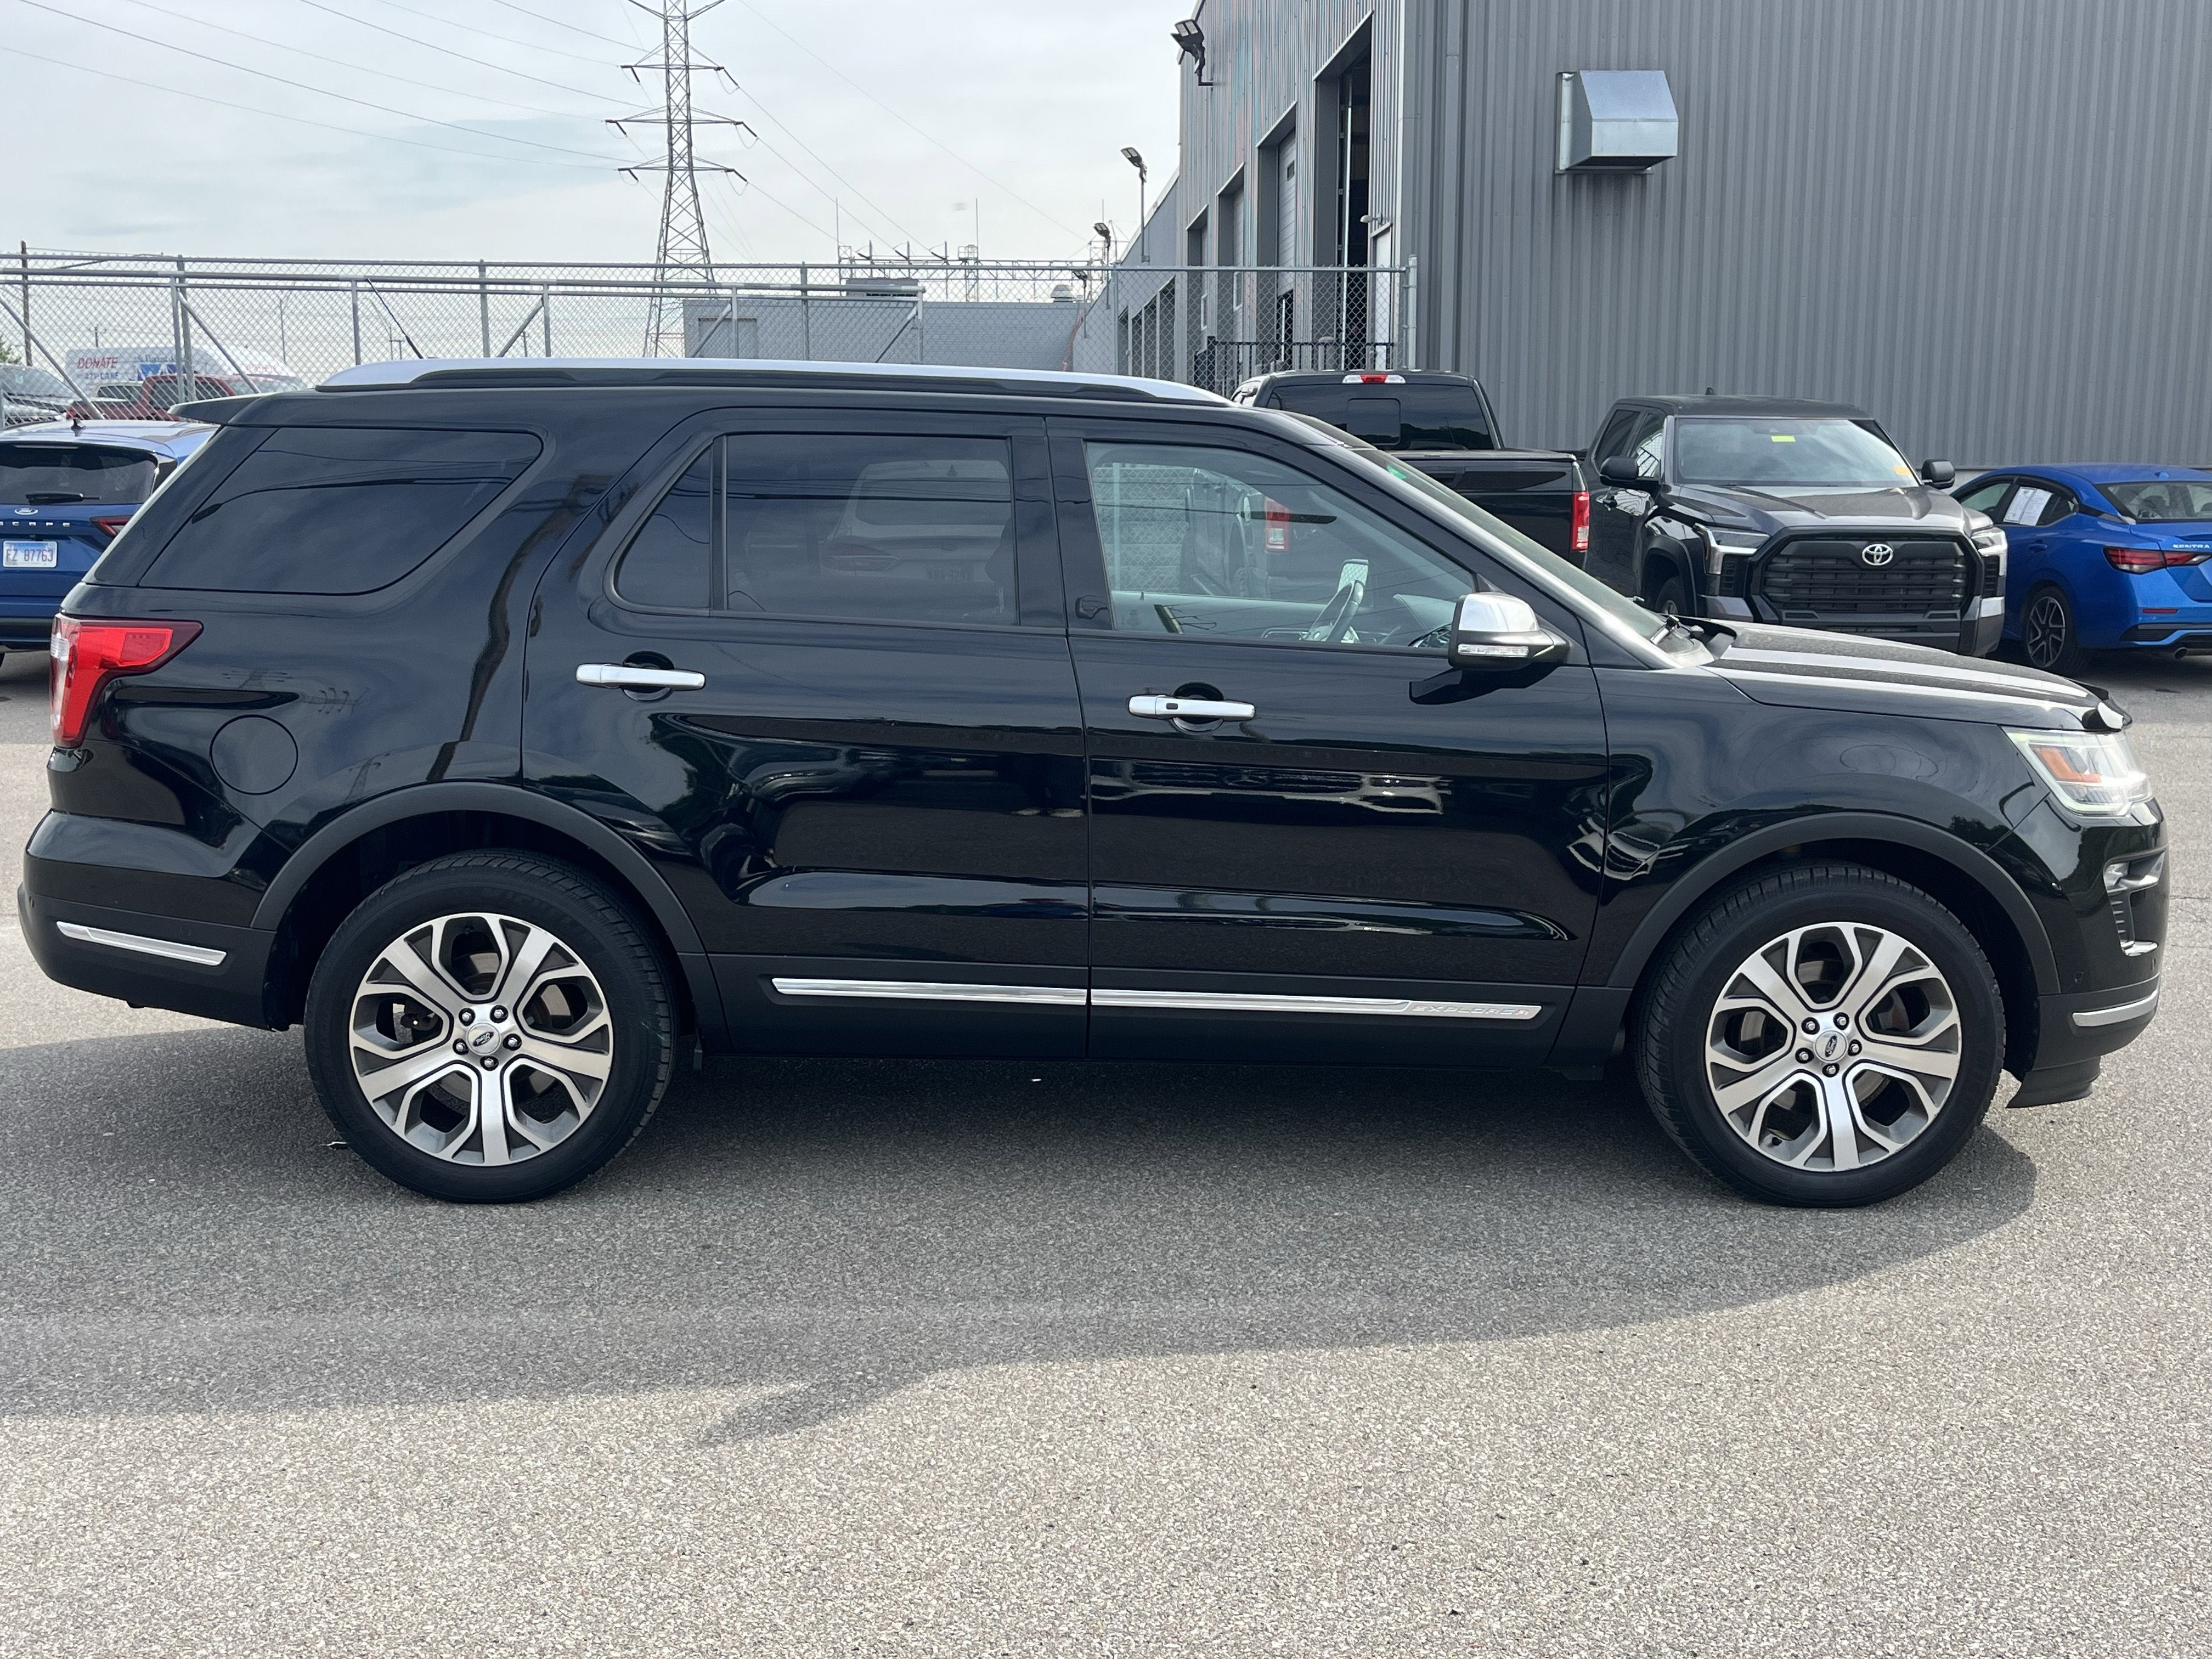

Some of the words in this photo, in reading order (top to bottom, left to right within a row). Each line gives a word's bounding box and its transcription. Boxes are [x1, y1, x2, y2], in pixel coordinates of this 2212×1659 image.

[77, 357, 119, 369] DONATE
[24, 549, 53, 562] 87763
[1412, 1005, 1529, 1015] EXPLORER
